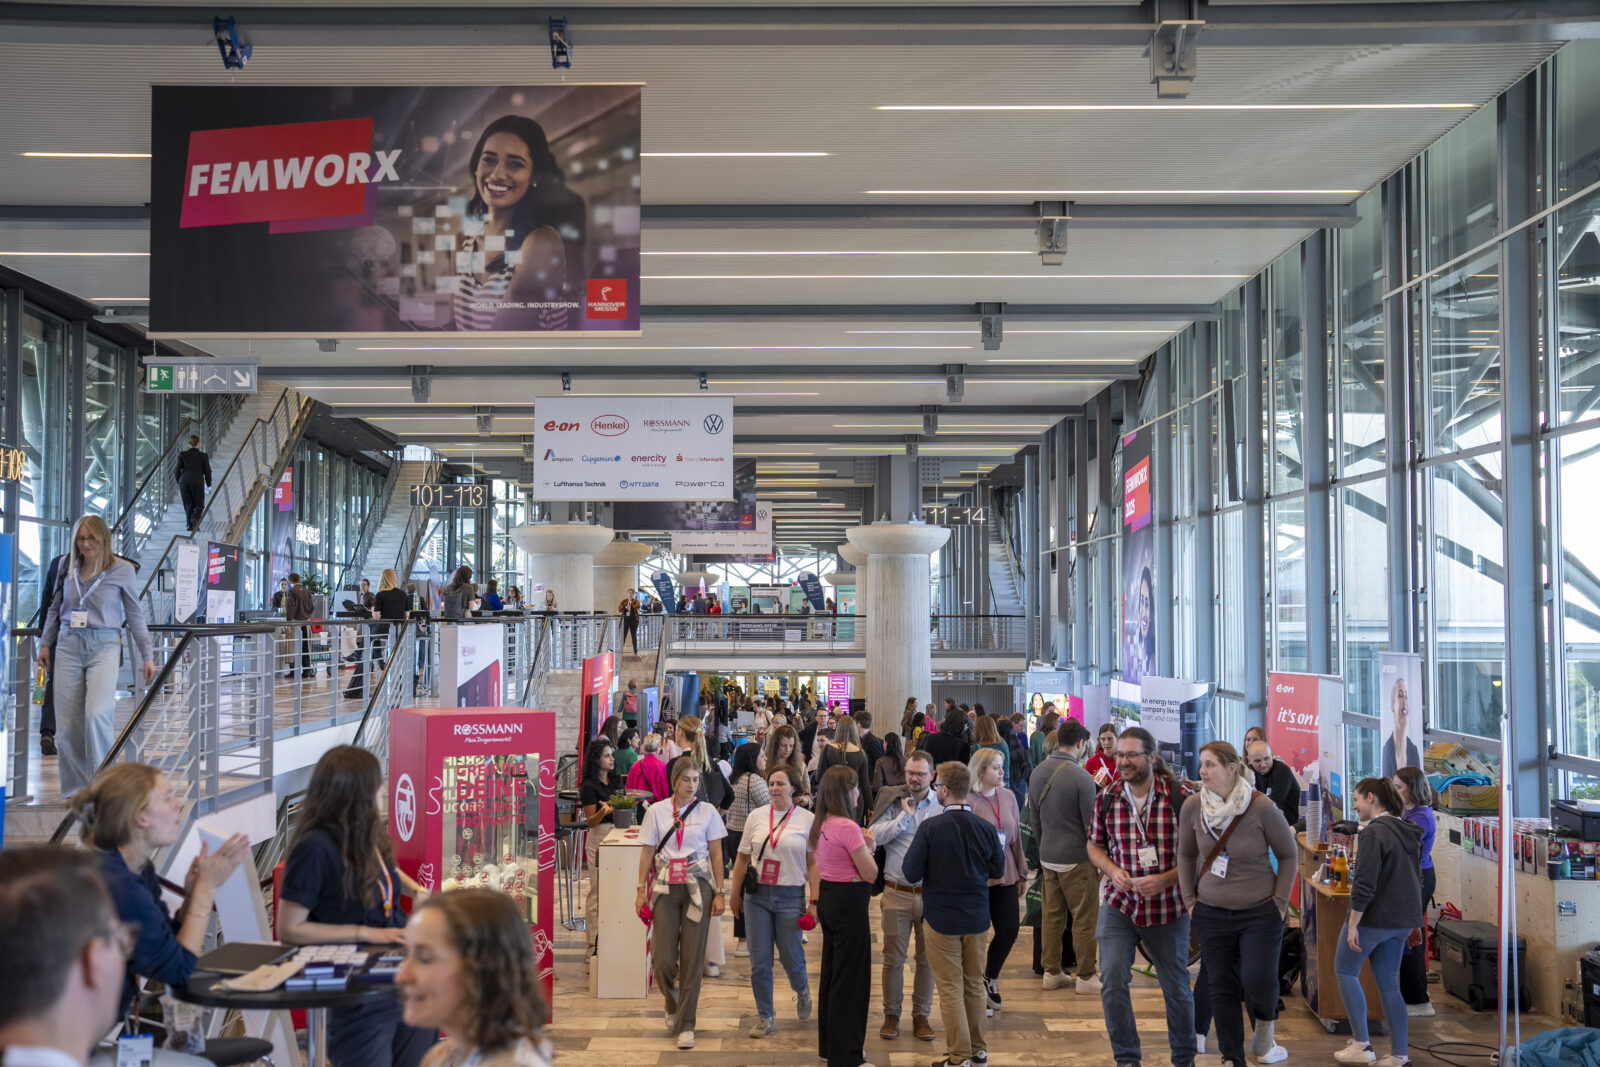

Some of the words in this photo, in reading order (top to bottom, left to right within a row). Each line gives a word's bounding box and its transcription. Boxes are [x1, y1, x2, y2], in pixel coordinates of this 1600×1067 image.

[188, 149, 402, 197] FEMWORX
[594, 421, 626, 430] Henkel
[581, 454, 614, 465] Capgemini
[631, 453, 667, 464] enercity
[411, 485, 483, 507] 101-113
[1149, 699, 1167, 707] energy
[1142, 706, 1166, 715] company
[1277, 707, 1296, 723] it's
[1297, 713, 1314, 726] on
[453, 722, 523, 735] ROSSMANN
[456, 777, 527, 800] DEINE
